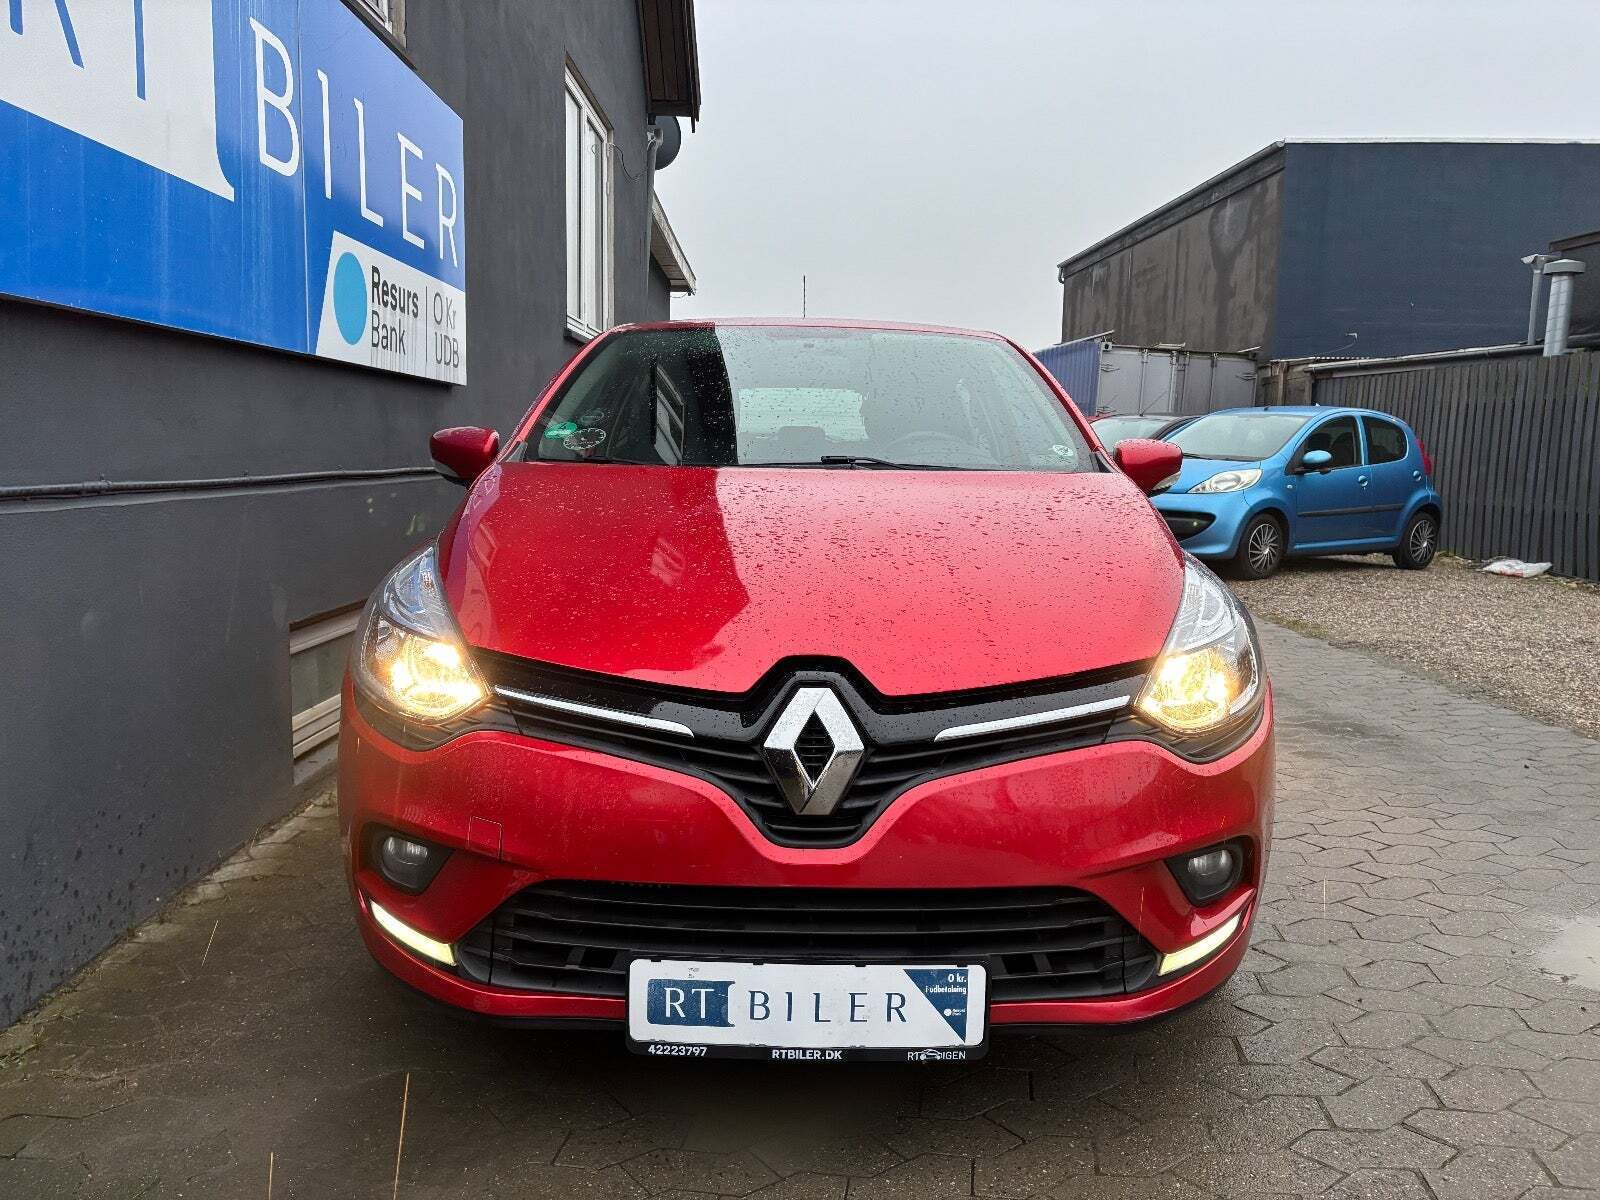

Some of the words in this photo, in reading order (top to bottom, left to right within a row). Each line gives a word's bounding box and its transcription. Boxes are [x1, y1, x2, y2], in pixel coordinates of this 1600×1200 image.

[249, 16, 458, 267] BILER
[371, 265, 419, 318] Resurs
[371, 310, 406, 355] Bank
[434, 331, 460, 368] UDB
[664, 987, 715, 1019] RT
[748, 990, 907, 1023] BILER
[648, 1044, 707, 1056] 42223797
[771, 1049, 842, 1060] RTBILER.DK
